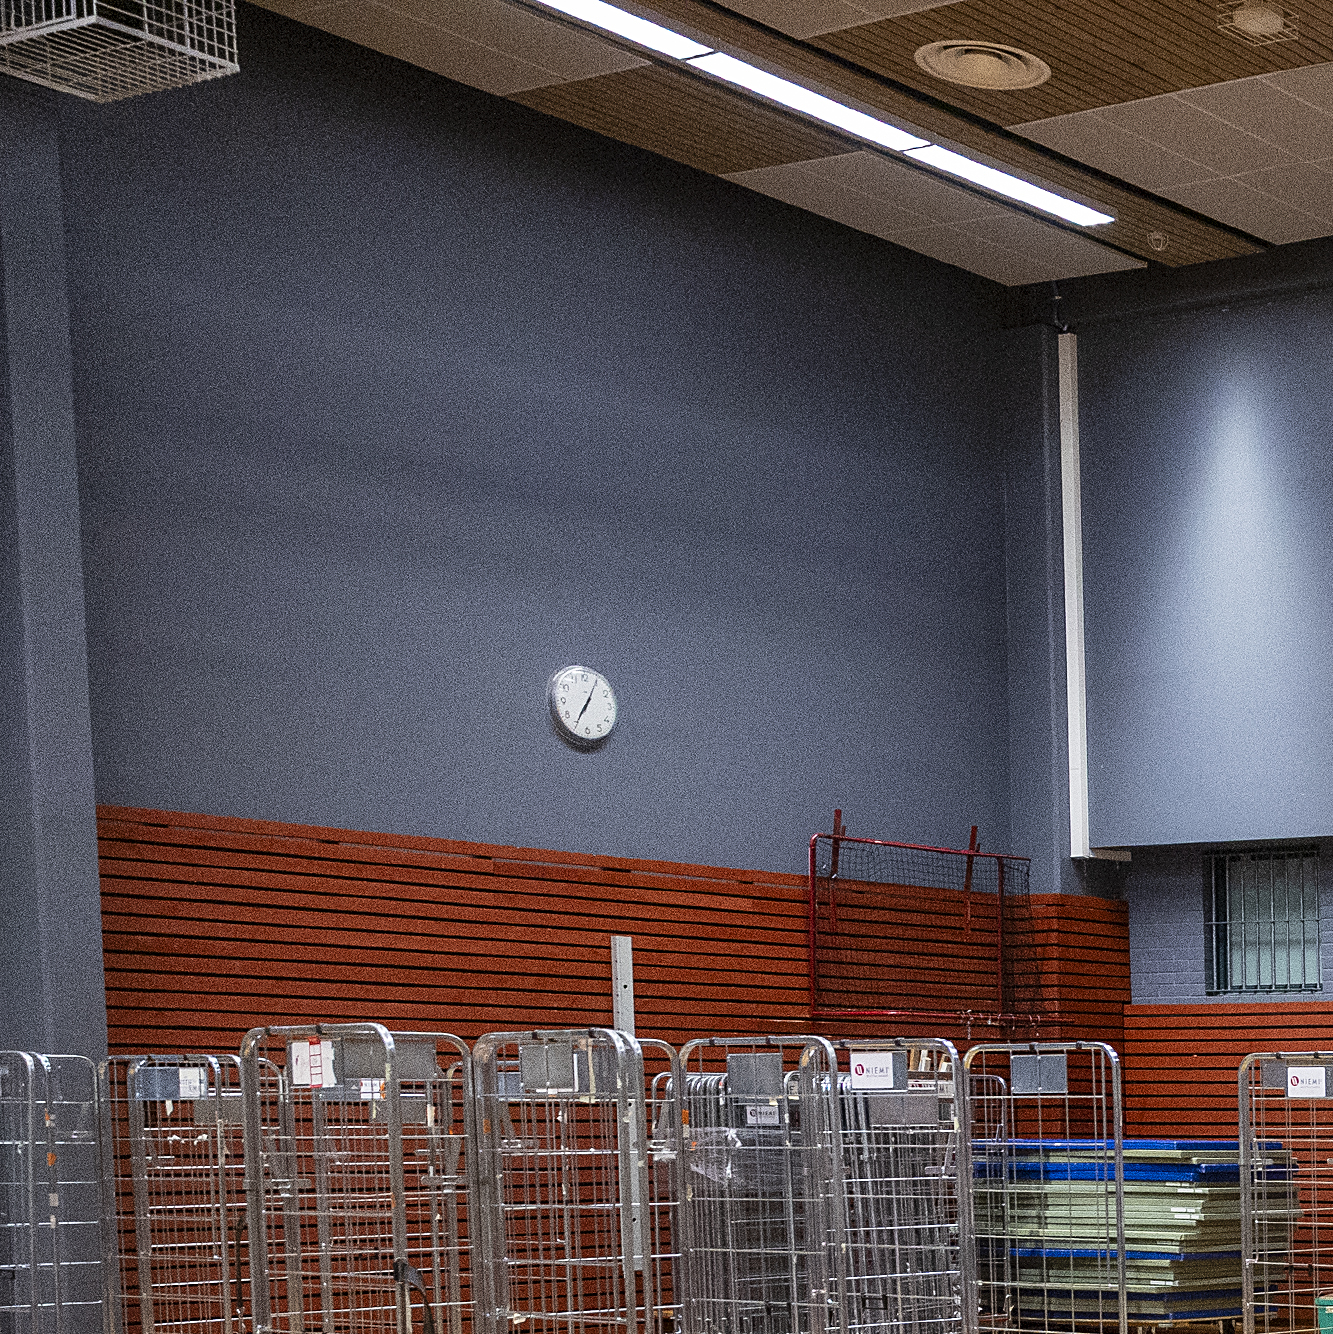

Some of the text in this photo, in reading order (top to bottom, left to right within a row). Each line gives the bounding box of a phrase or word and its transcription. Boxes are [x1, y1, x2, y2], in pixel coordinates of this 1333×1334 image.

[602, 689, 609, 698] 2
[560, 696, 567, 705] 9
[607, 702, 613, 711] 3
[564, 710, 571, 719] 8
[584, 726, 591, 735] 6
[596, 723, 603, 733] 5
[866, 1066, 889, 1074] NIEMI
[1300, 1078, 1321, 1086] NIEMI
